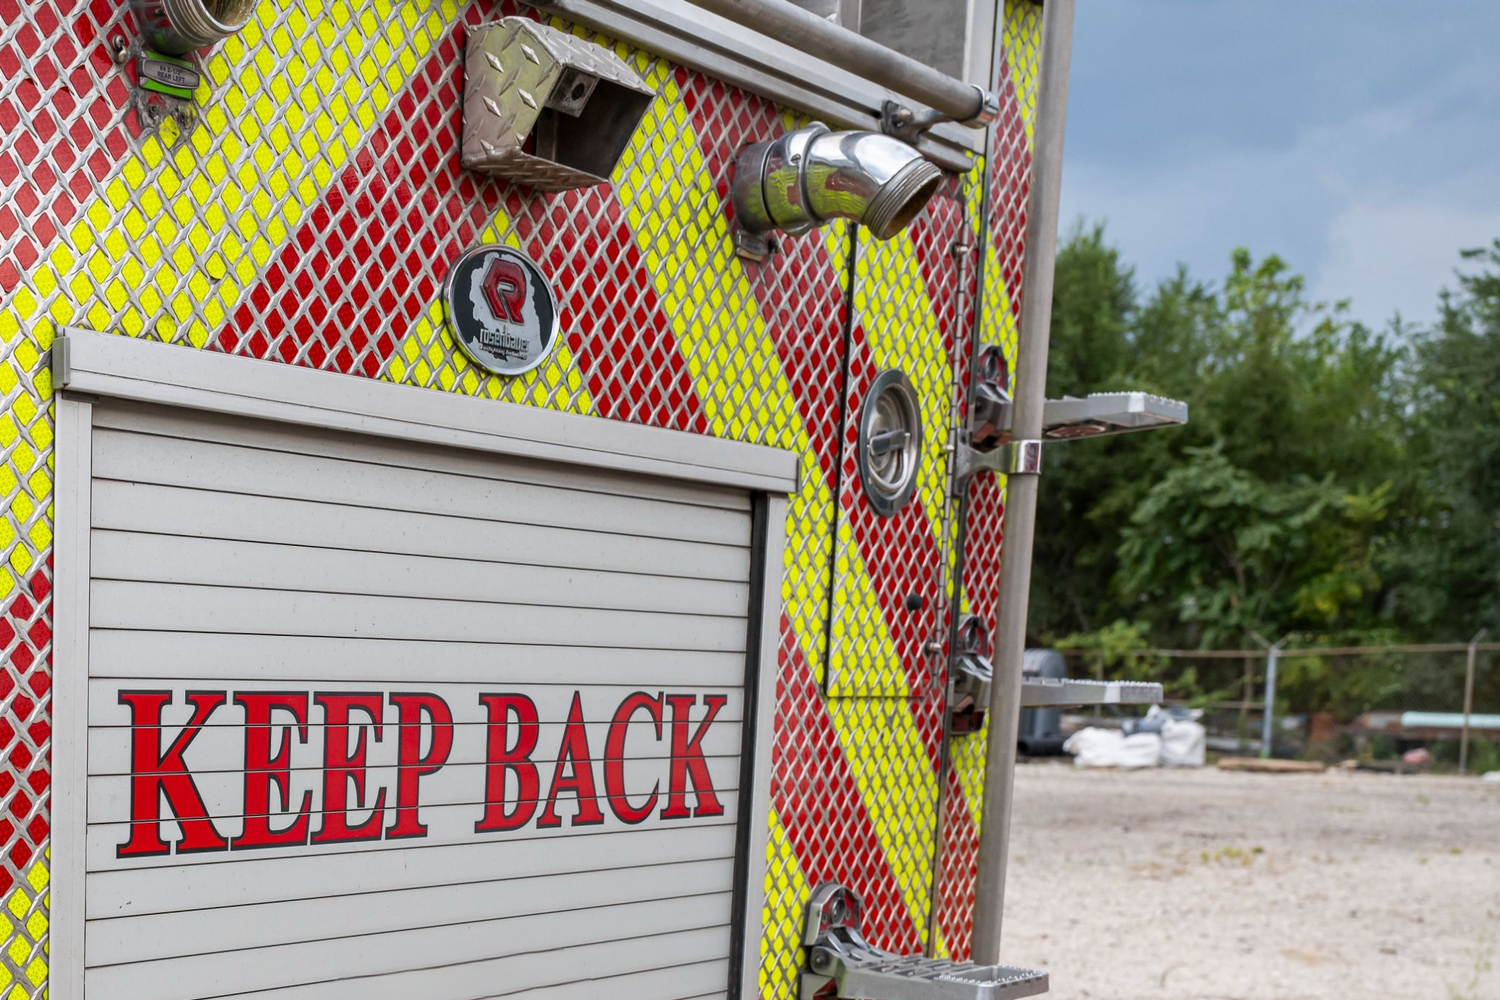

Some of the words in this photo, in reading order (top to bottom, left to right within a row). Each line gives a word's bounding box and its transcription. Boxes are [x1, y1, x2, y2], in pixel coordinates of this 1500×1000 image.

[157, 71, 171, 80] REAR
[173, 74, 185, 83] LEFT
[480, 326, 529, 352] rosenbauer
[116, 690, 454, 858] KEEP
[475, 690, 728, 834] BACK
